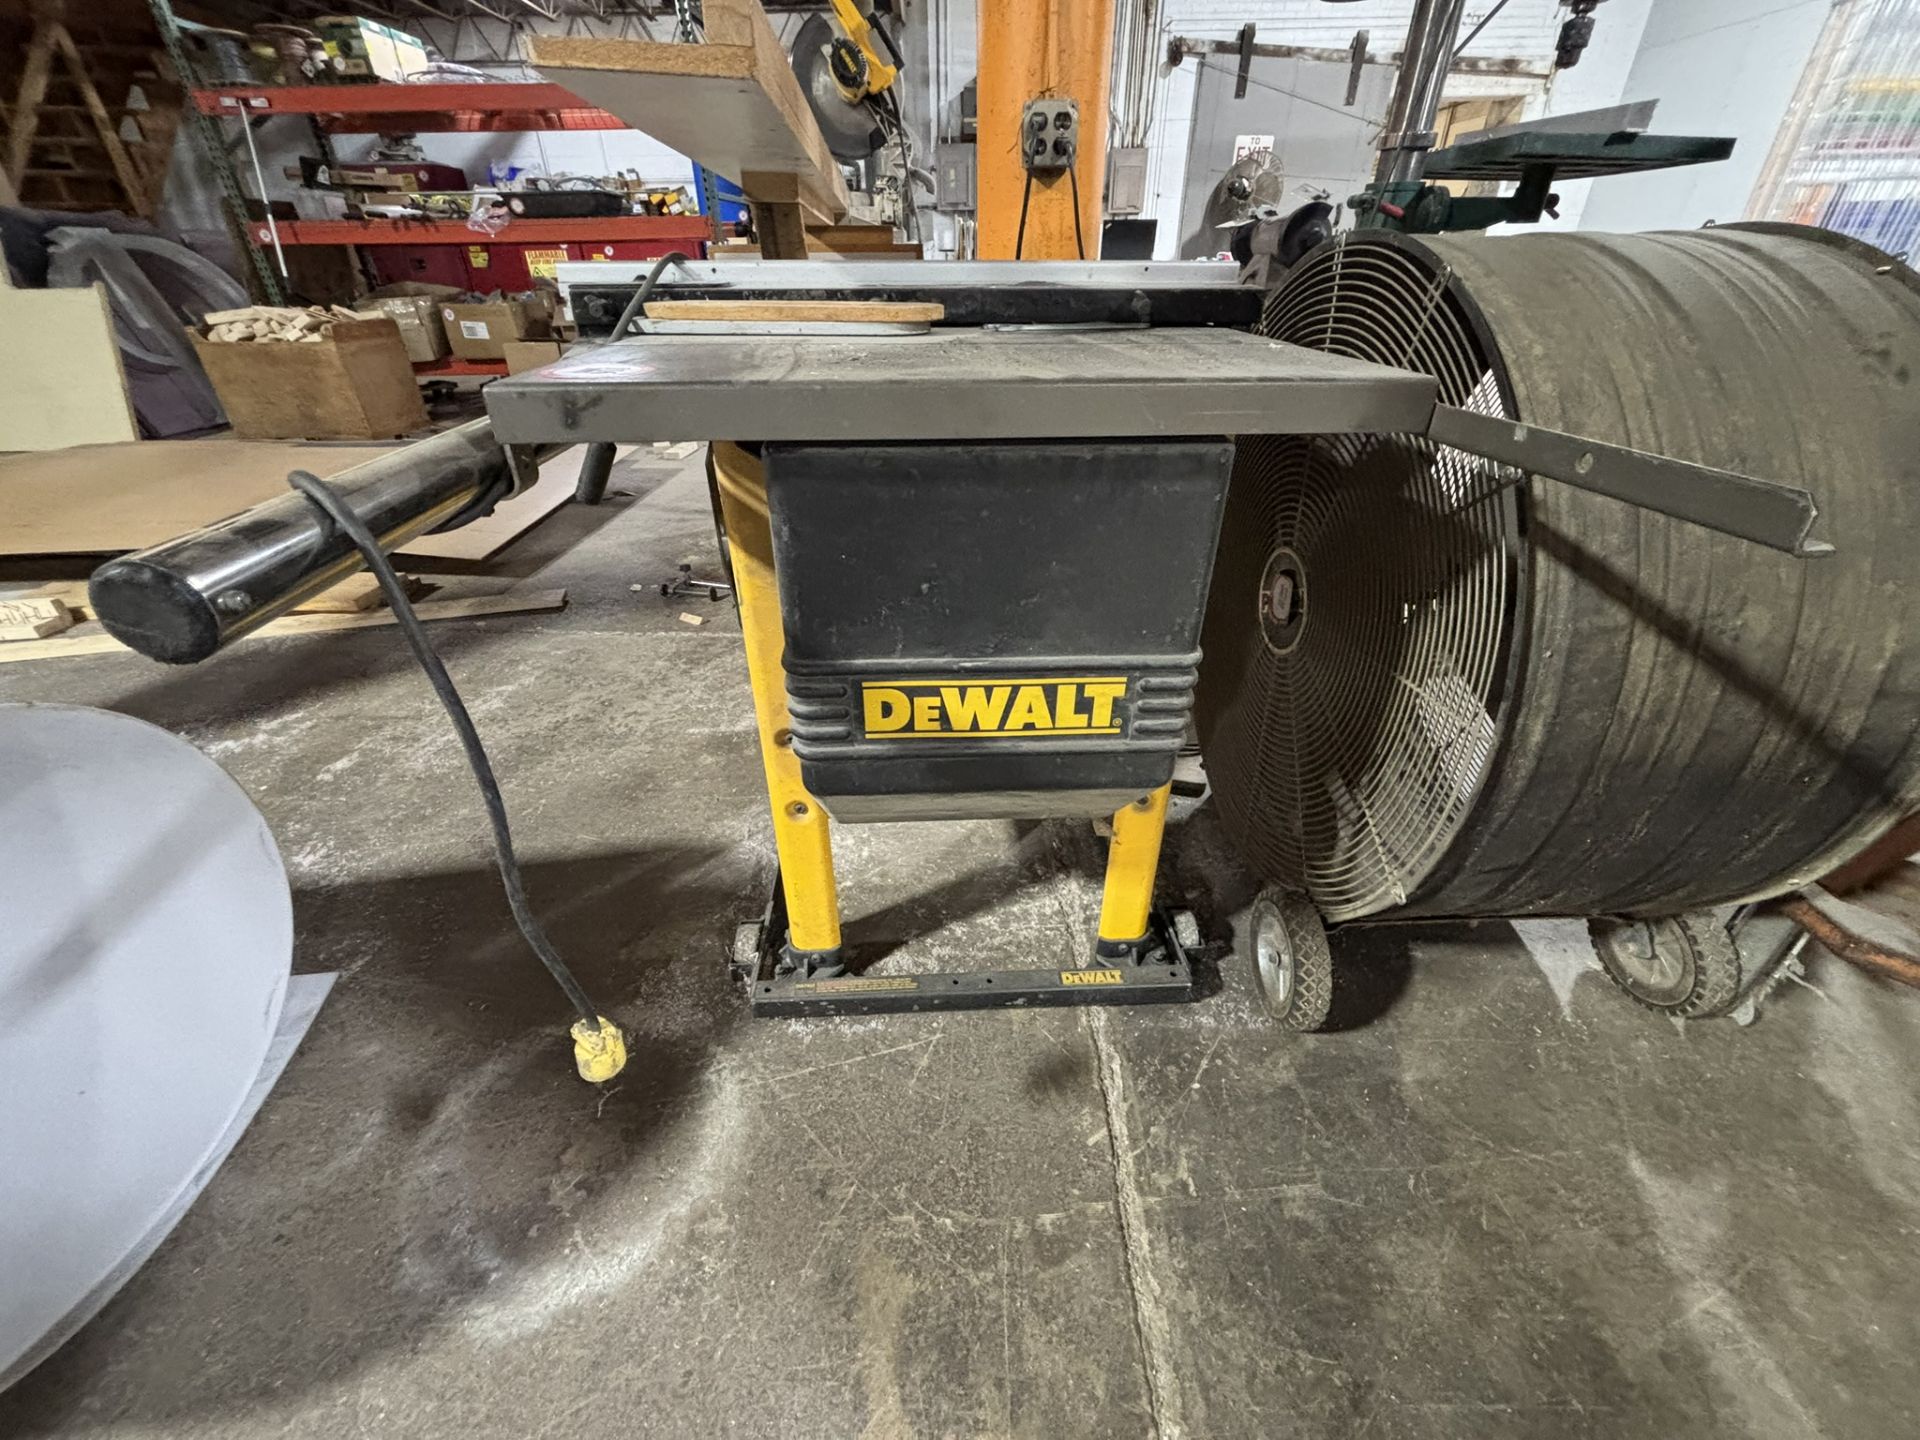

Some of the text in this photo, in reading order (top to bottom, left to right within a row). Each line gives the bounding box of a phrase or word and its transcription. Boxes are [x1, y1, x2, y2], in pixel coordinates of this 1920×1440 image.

[1250, 137, 1261, 145] TO
[862, 684, 1127, 732] DEWALT
[1061, 970, 1122, 985] DEWALT
